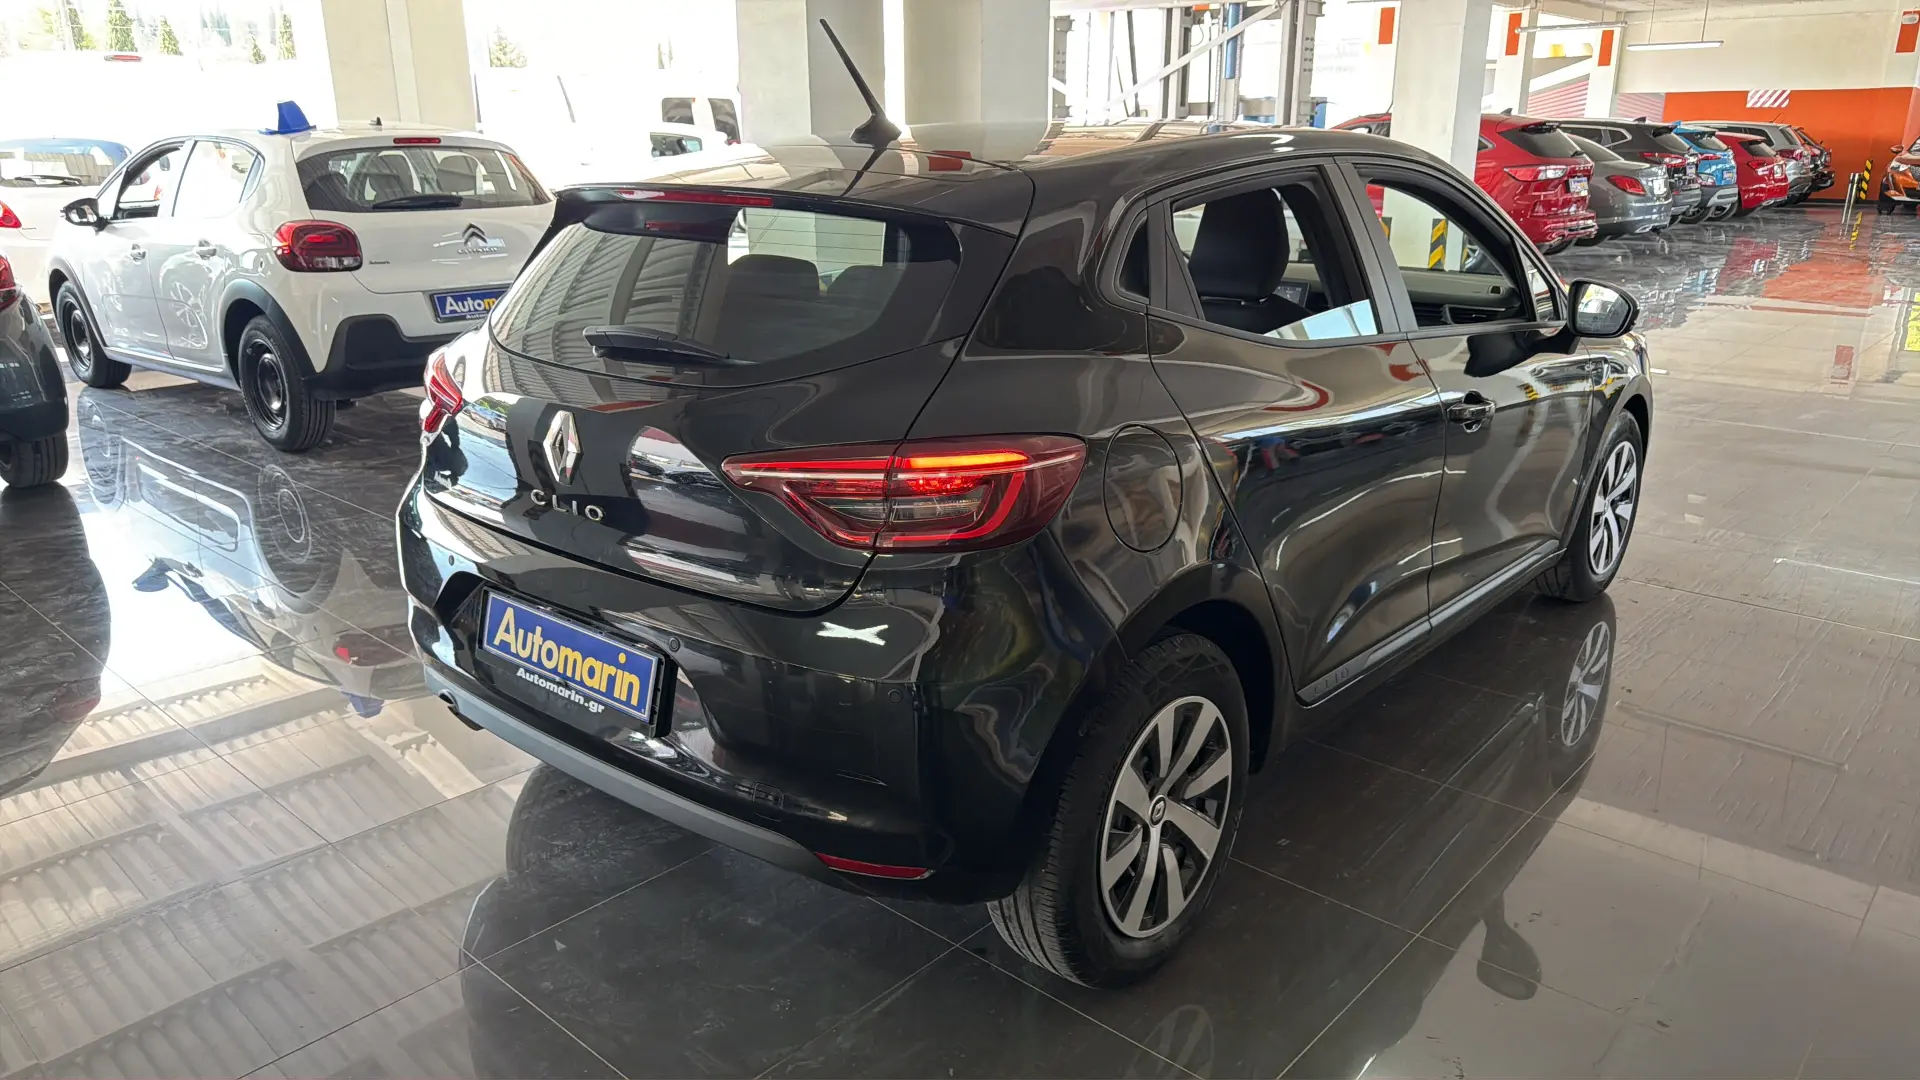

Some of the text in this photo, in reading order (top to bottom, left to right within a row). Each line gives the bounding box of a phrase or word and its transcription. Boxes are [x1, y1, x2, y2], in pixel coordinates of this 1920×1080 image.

[530, 488, 604, 521] CLIO
[493, 606, 641, 707] Automarin
[516, 667, 605, 714] Automarin.gr
